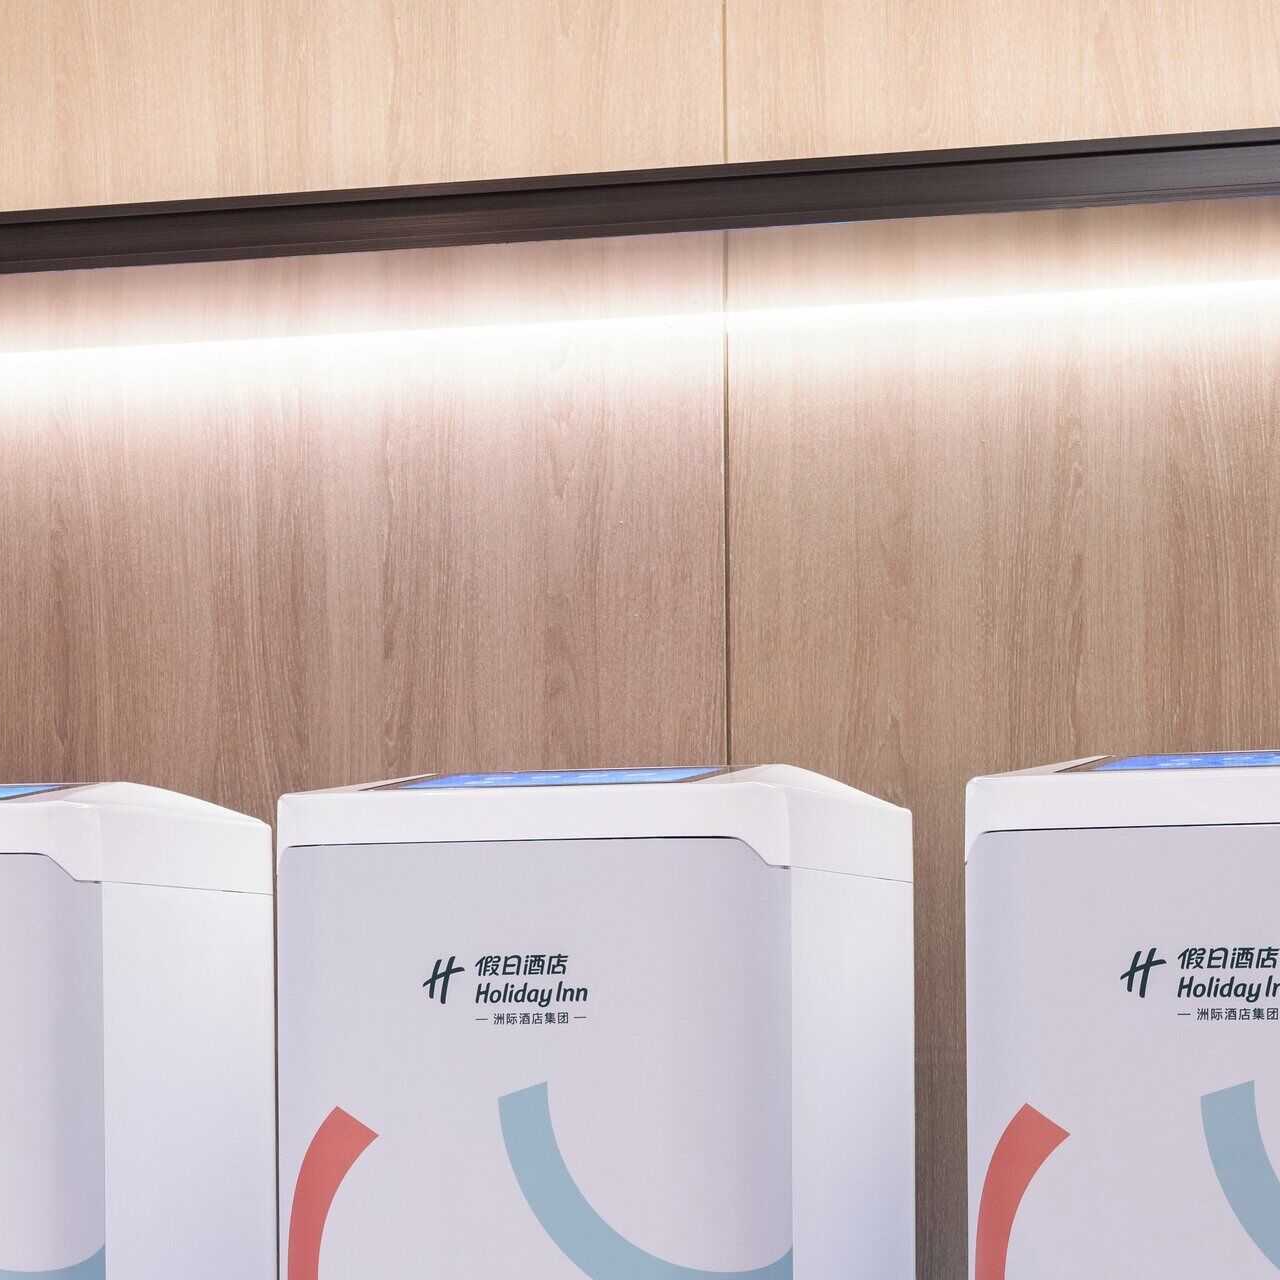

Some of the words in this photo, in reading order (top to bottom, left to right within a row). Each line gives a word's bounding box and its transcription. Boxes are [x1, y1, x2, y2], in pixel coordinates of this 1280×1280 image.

[475, 953, 569, 977] 假日酒店
[1177, 946, 1280, 970] 假日酒店
[475, 982, 552, 1008] Holiday
[555, 981, 589, 1002] Inn
[1177, 975, 1261, 1003] Holiday
[493, 1012, 569, 1025] 洲际酒店集团
[1196, 1007, 1280, 1021] 洲际酒店集团
